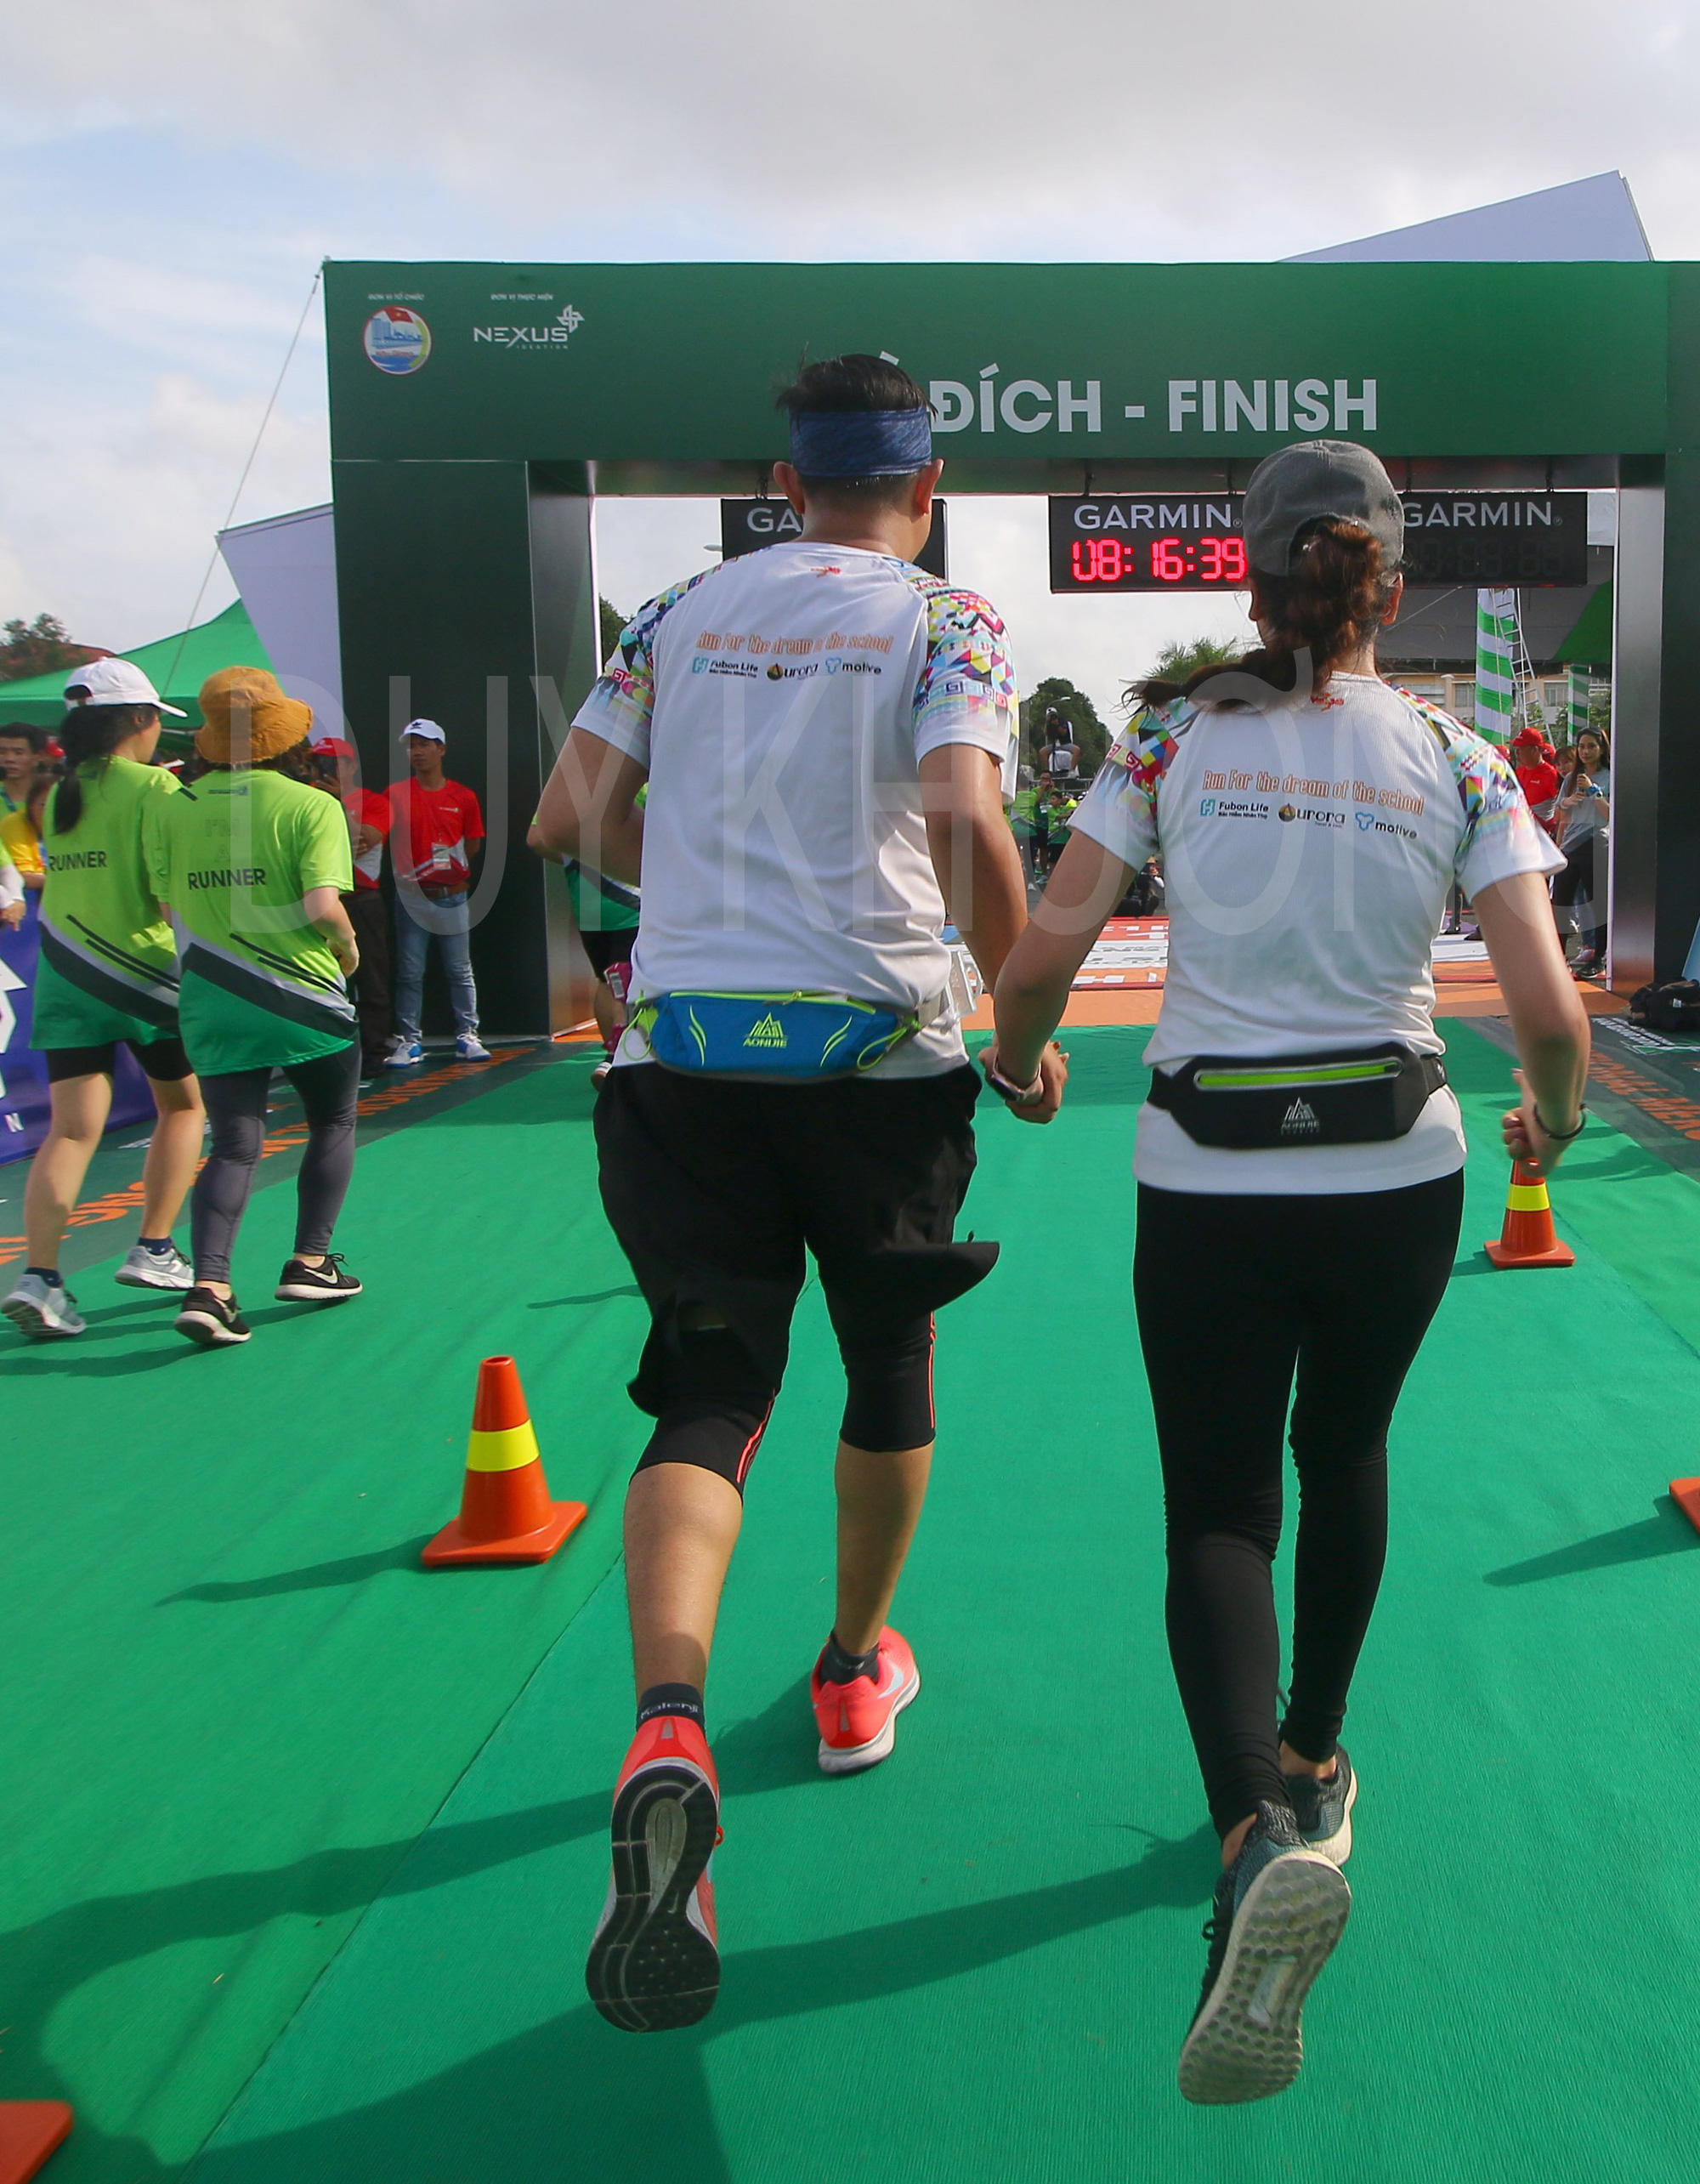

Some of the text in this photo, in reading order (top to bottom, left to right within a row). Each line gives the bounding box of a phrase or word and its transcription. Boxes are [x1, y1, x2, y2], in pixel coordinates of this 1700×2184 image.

[473, 327, 569, 349] NEXUS
[928, 362, 1102, 433] ĐÍCH
[1168, 378, 1377, 432] FINISH
[1074, 503, 1232, 530] GARMIN
[1402, 501, 1552, 528] GARMIN
[1203, 769, 1425, 816] Run For the dream of the school
[1219, 802, 1269, 813] Fubon Life
[1375, 821, 1418, 840] motive
[48, 851, 107, 871] RUNNER
[188, 868, 267, 890] RUNNER
